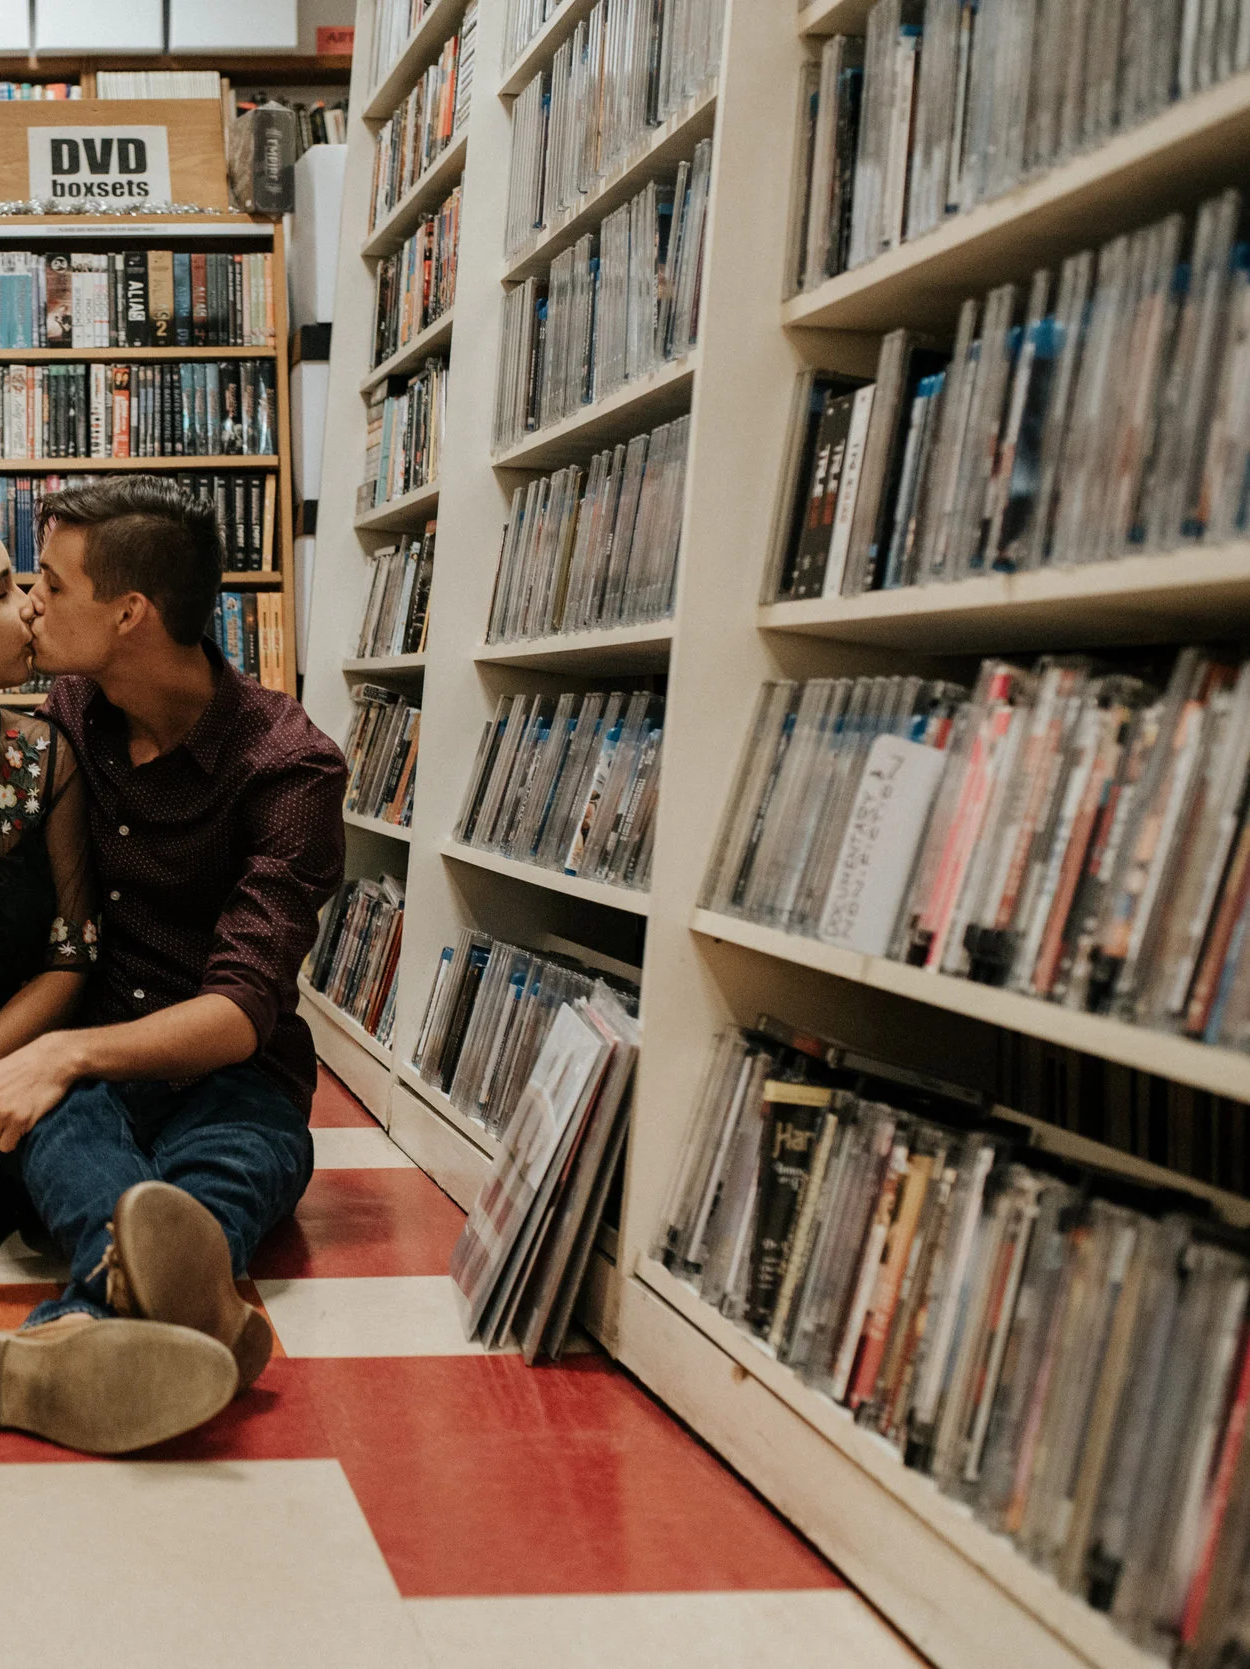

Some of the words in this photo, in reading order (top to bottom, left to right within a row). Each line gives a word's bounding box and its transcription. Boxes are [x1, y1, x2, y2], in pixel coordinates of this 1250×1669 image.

[50, 138, 147, 175] DVD
[51, 179, 150, 198] boxsets
[128, 280, 146, 322] ALIAS
[156, 320, 167, 337] 2
